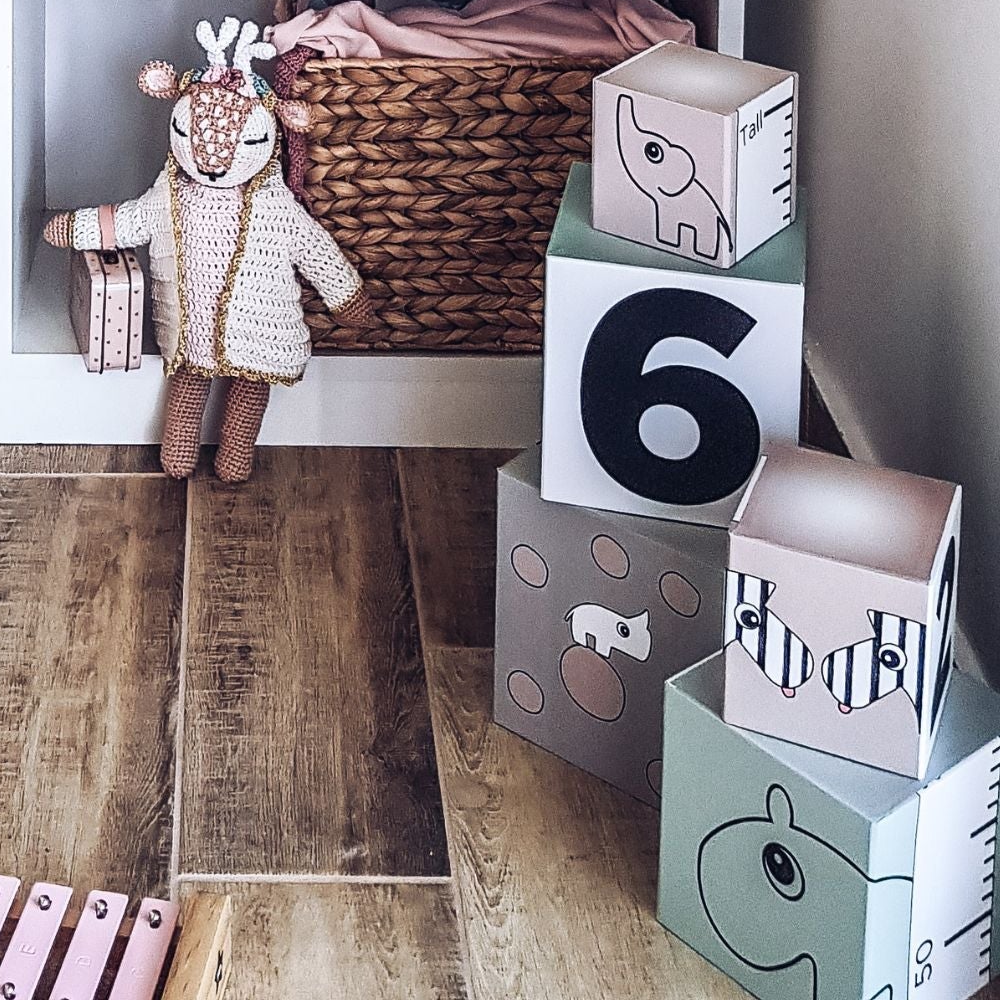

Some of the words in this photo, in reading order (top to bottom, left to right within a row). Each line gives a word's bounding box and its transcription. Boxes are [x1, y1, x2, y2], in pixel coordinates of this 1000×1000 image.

[740, 109, 762, 146] Tall
[579, 287, 761, 506] 6
[930, 535, 956, 737] 2
[914, 939, 933, 988] 50
